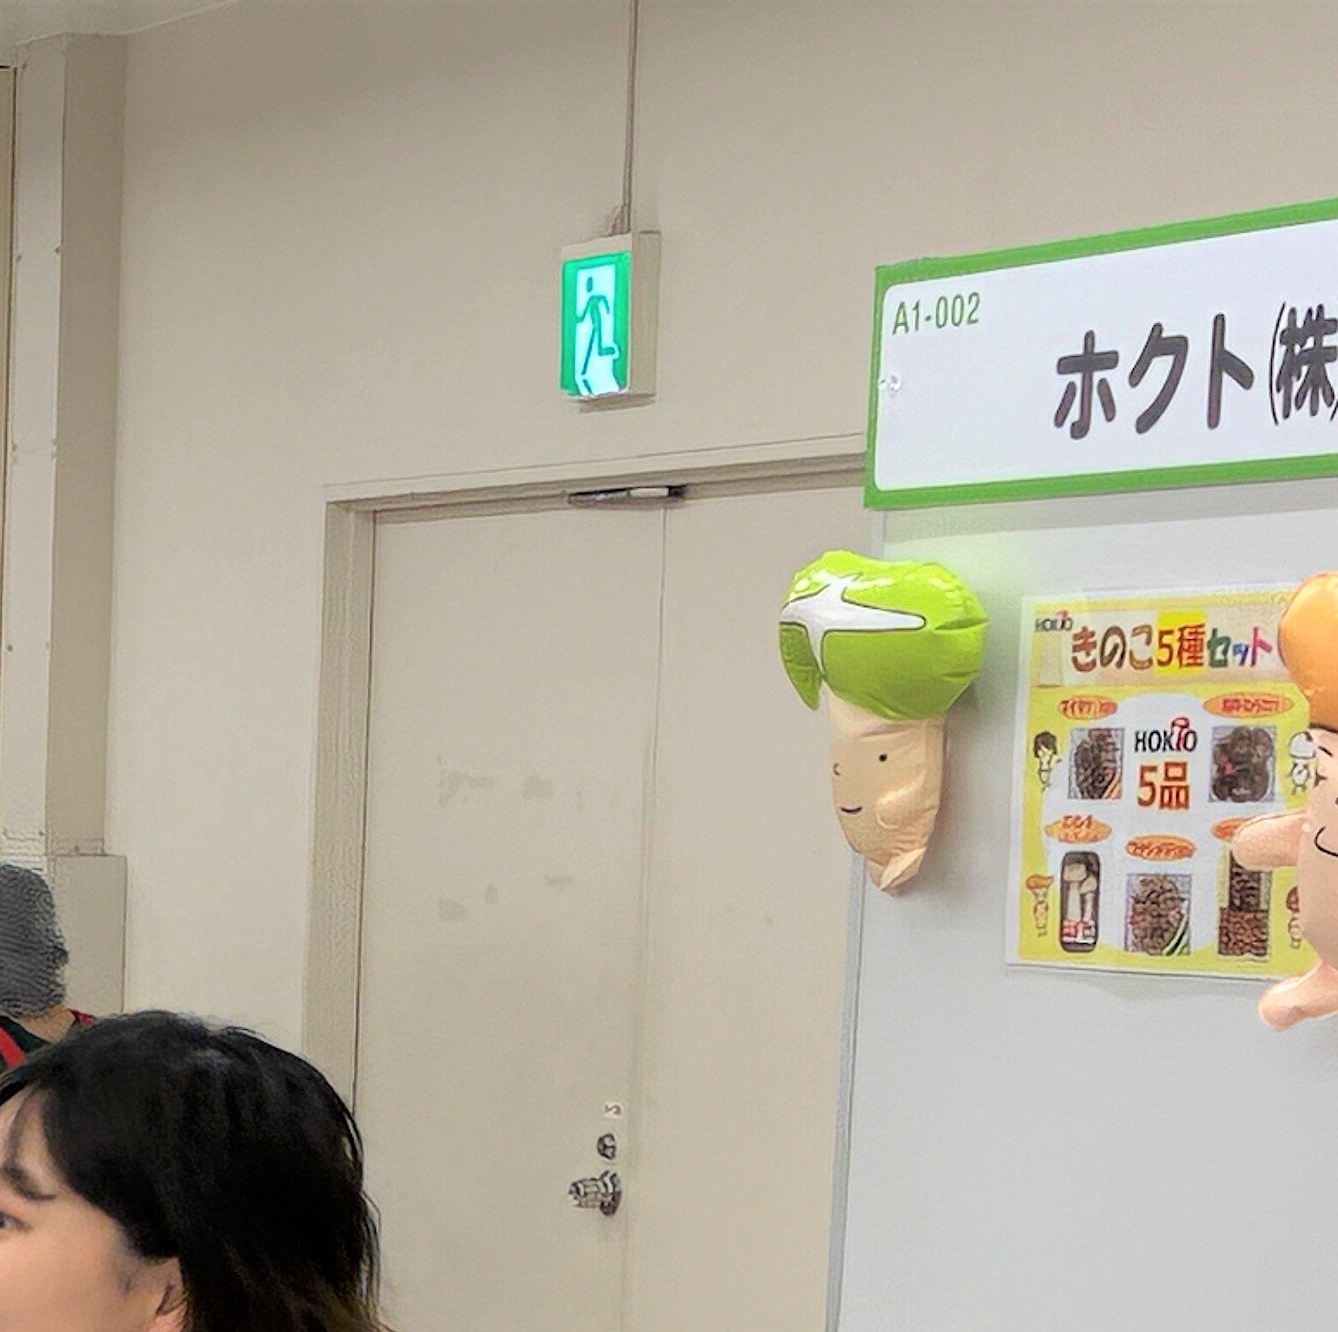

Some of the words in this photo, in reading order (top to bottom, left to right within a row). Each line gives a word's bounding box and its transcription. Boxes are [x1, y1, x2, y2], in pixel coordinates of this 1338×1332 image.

[892, 291, 980, 335] A1-002
[1054, 302, 1338, 439] ホクト(株
[1071, 622, 1273, 673] きのこ5種セット
[1137, 761, 1190, 811] 5品
